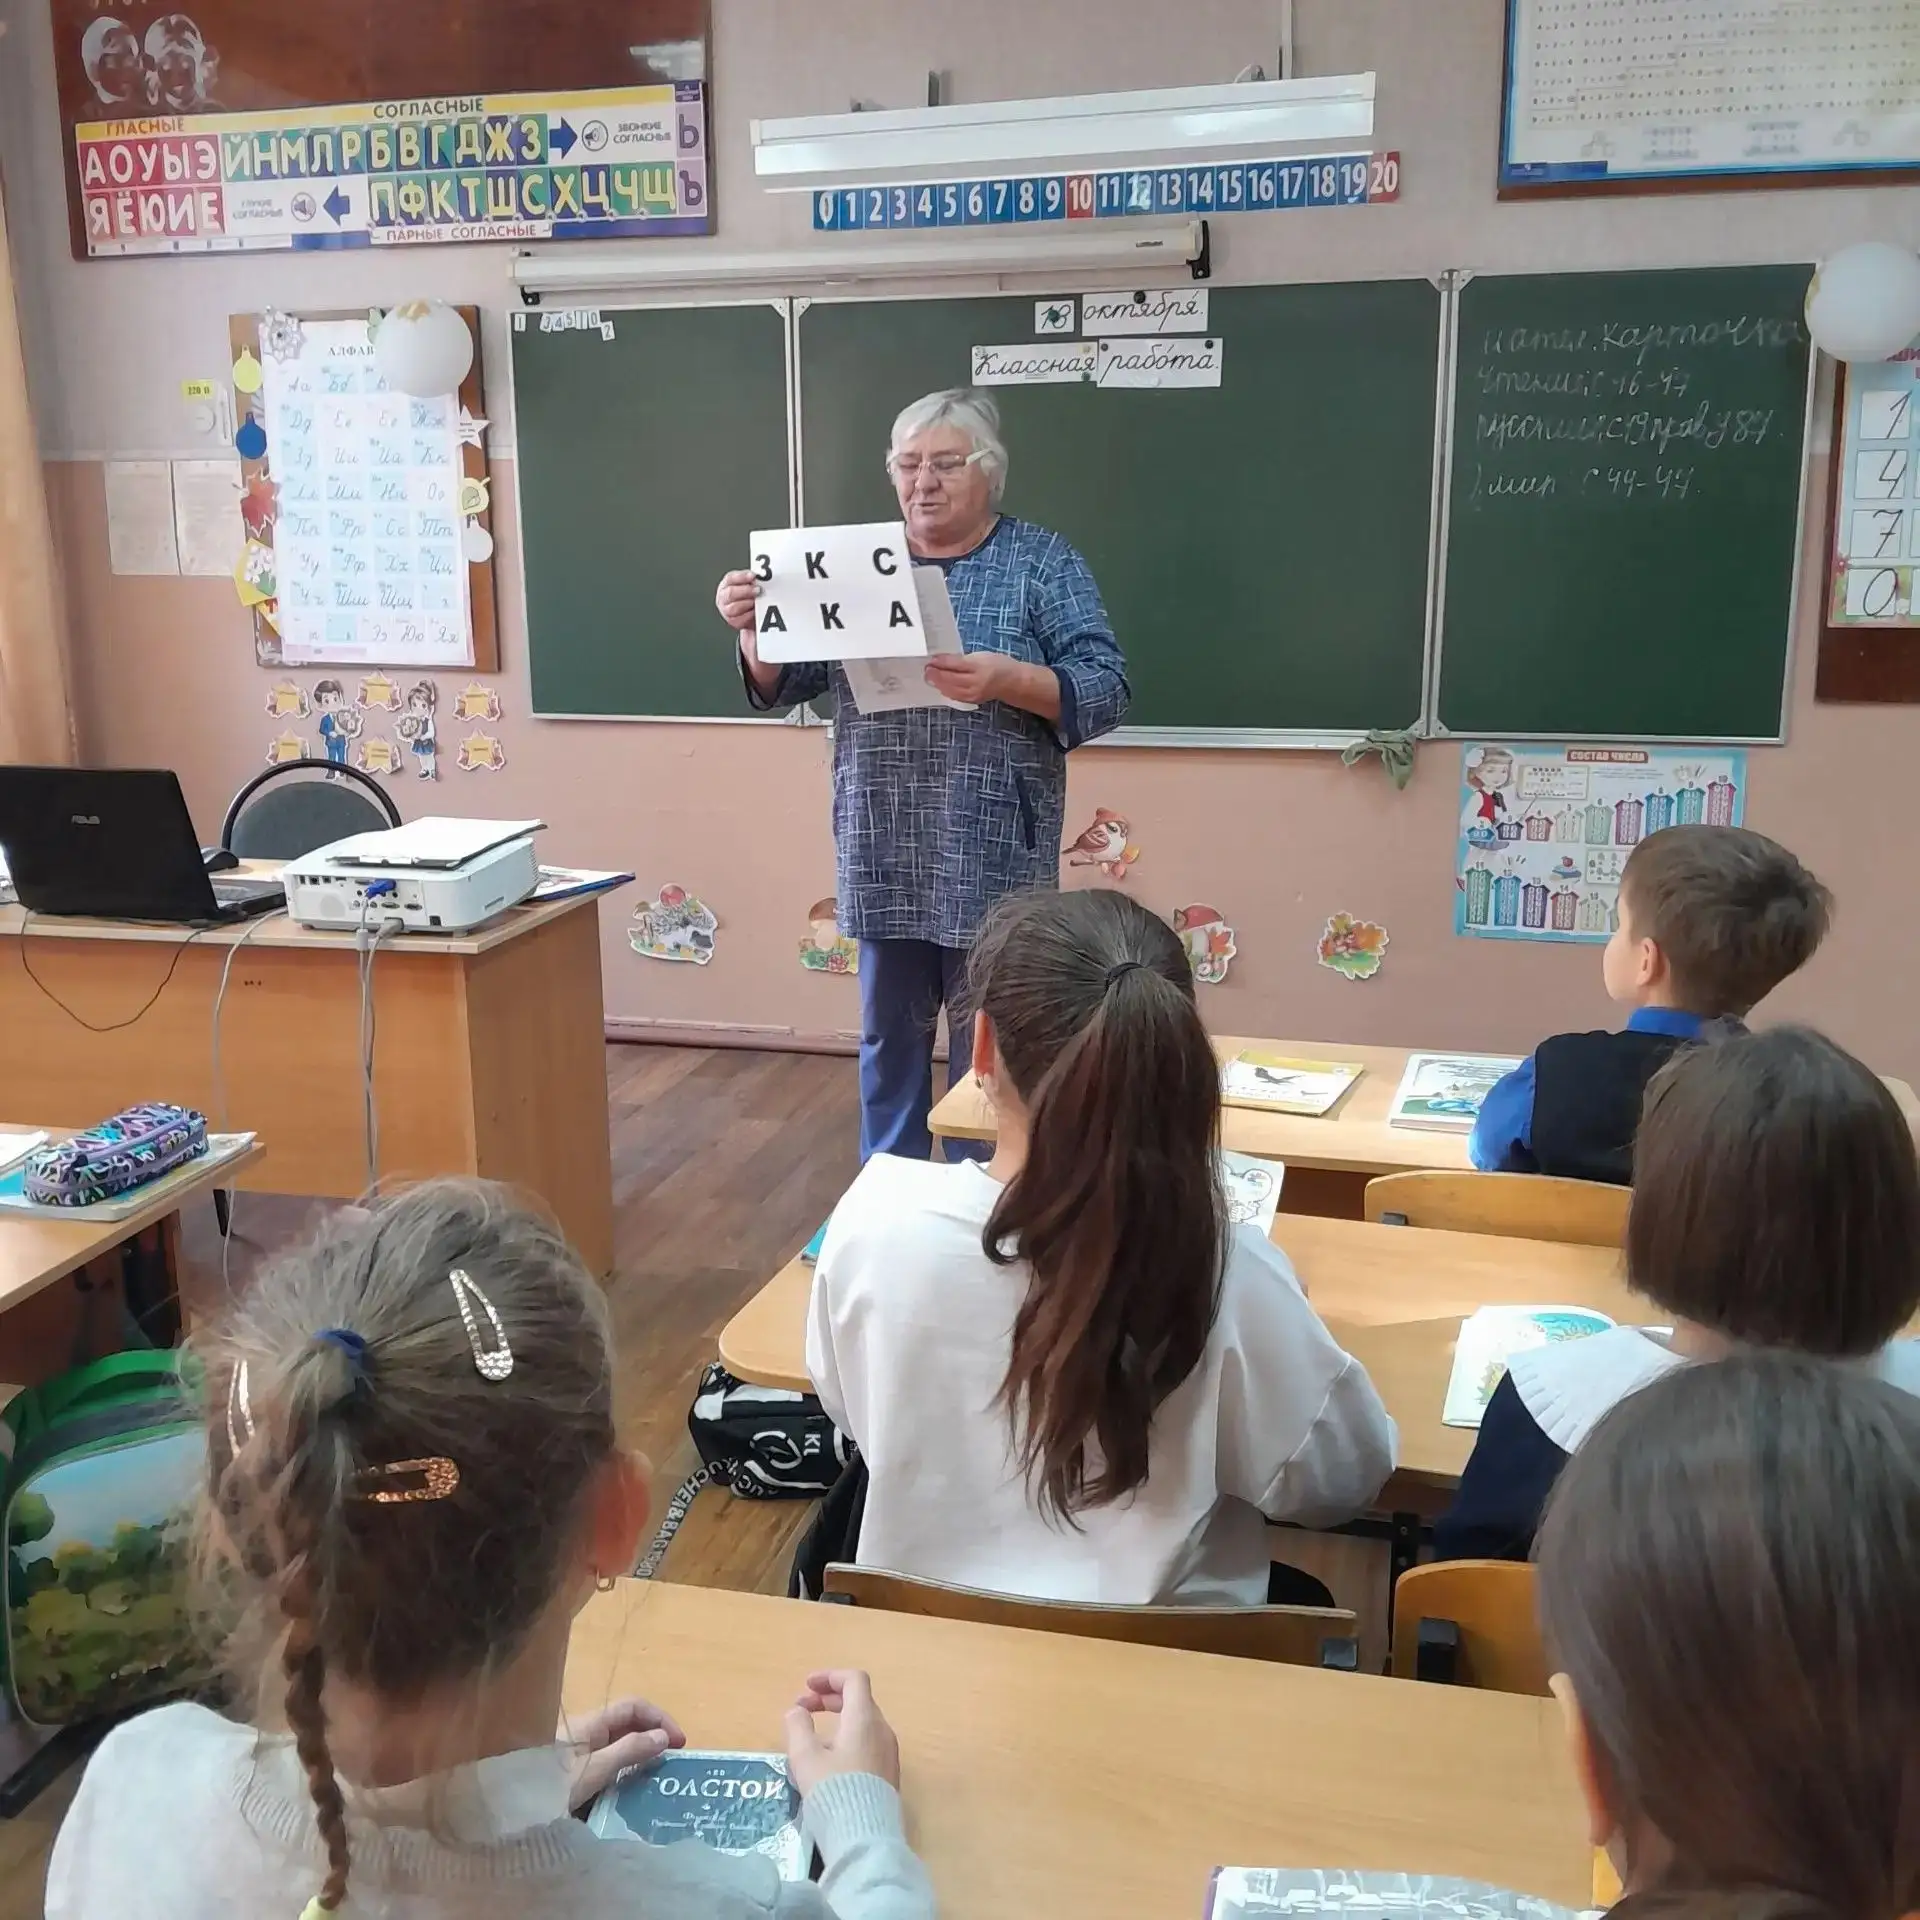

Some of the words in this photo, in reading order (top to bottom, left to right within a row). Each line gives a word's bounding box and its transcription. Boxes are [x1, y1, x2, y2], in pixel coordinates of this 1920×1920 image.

[373, 97, 484, 118] СОГЛАСНЫЕ
[105, 116, 185, 136] ГЛАСНЫЕ
[819, 191, 833, 224] 0
[845, 192, 856, 223] 1
[869, 190, 883, 221] 2
[894, 189, 907, 220] 3
[918, 187, 933, 218] 4
[943, 186, 956, 218] 5
[968, 184, 982, 216] 6
[993, 183, 1008, 214] 7
[1019, 181, 1034, 213] 8
[1045, 180, 1060, 212] 9
[1069, 178, 1092, 211] 10
[1098, 176, 1120, 208] 11
[1127, 174, 1151, 209] 12
[1158, 173, 1181, 205] 13
[1188, 171, 1213, 204] 14
[1218, 170, 1242, 203] 15
[1248, 168, 1274, 201] 16
[1278, 166, 1305, 200] 17
[1309, 164, 1335, 198] 18
[1340, 162, 1367, 196] 19
[1370, 160, 1398, 194] 20
[386, 229, 444, 241] ПАРНЫЕ
[451, 224, 537, 239] СОГЛАСНЫЕ
[328, 345, 375, 357] АЛФАВ
[974, 352, 1095, 376] Классная
[1890, 391, 1912, 439] 1
[1879, 450, 1907, 499] 4
[1873, 509, 1904, 558] 7
[805, 551, 829, 579] К
[873, 547, 898, 576] С
[1863, 568, 1898, 616] 0
[760, 605, 787, 633] А
[820, 602, 845, 630] К
[889, 600, 914, 628] А
[1570, 751, 1610, 761] СОСТАВ
[1611, 751, 1646, 762] ЧИСЛА
